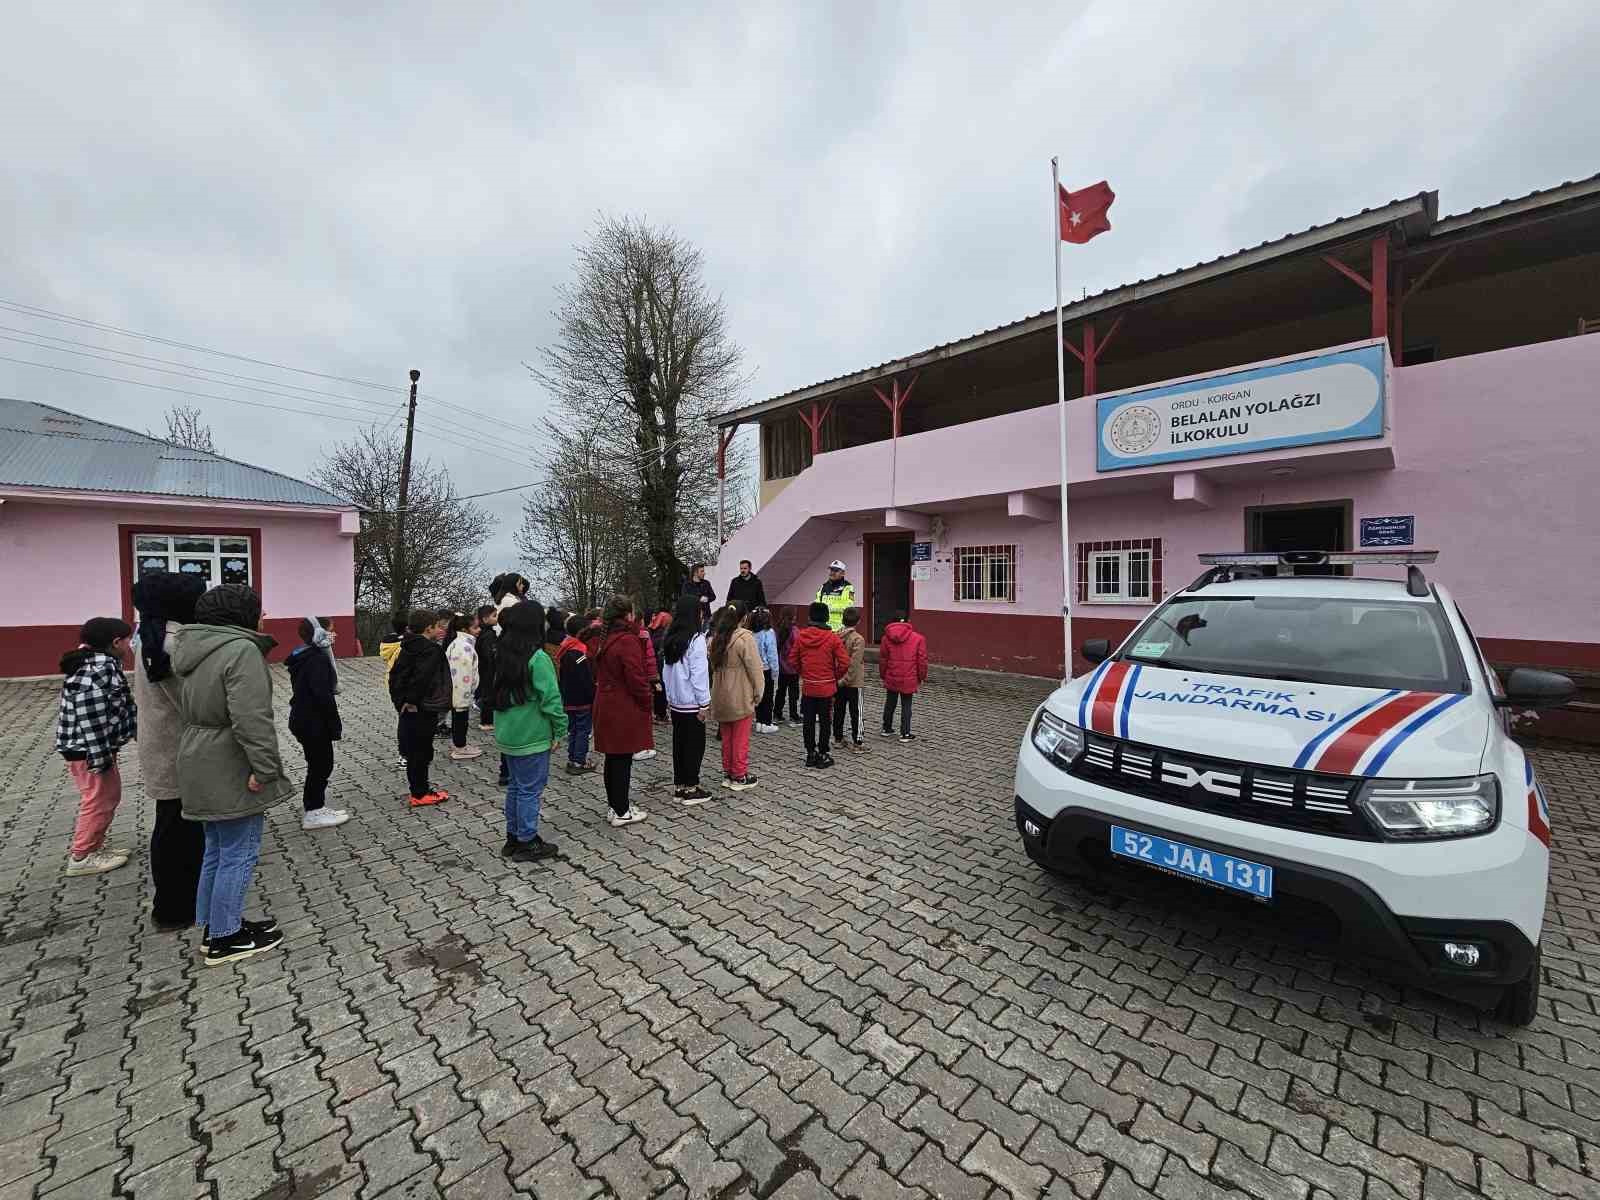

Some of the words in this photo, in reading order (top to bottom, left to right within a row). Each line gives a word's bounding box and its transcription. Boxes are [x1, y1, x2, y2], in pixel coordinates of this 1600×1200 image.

[1171, 398, 1200, 411] ORDU
[1207, 389, 1252, 405] KORGAN
[1171, 406, 1241, 428] BELALAN
[1245, 392, 1322, 417] YOLAĞZI
[1170, 422, 1249, 445] İLKOKULU
[1134, 690, 1337, 722] JANDARMASI
[1124, 831, 1153, 860] 52
[1164, 844, 1214, 878] JAA
[1225, 860, 1266, 893] 131
